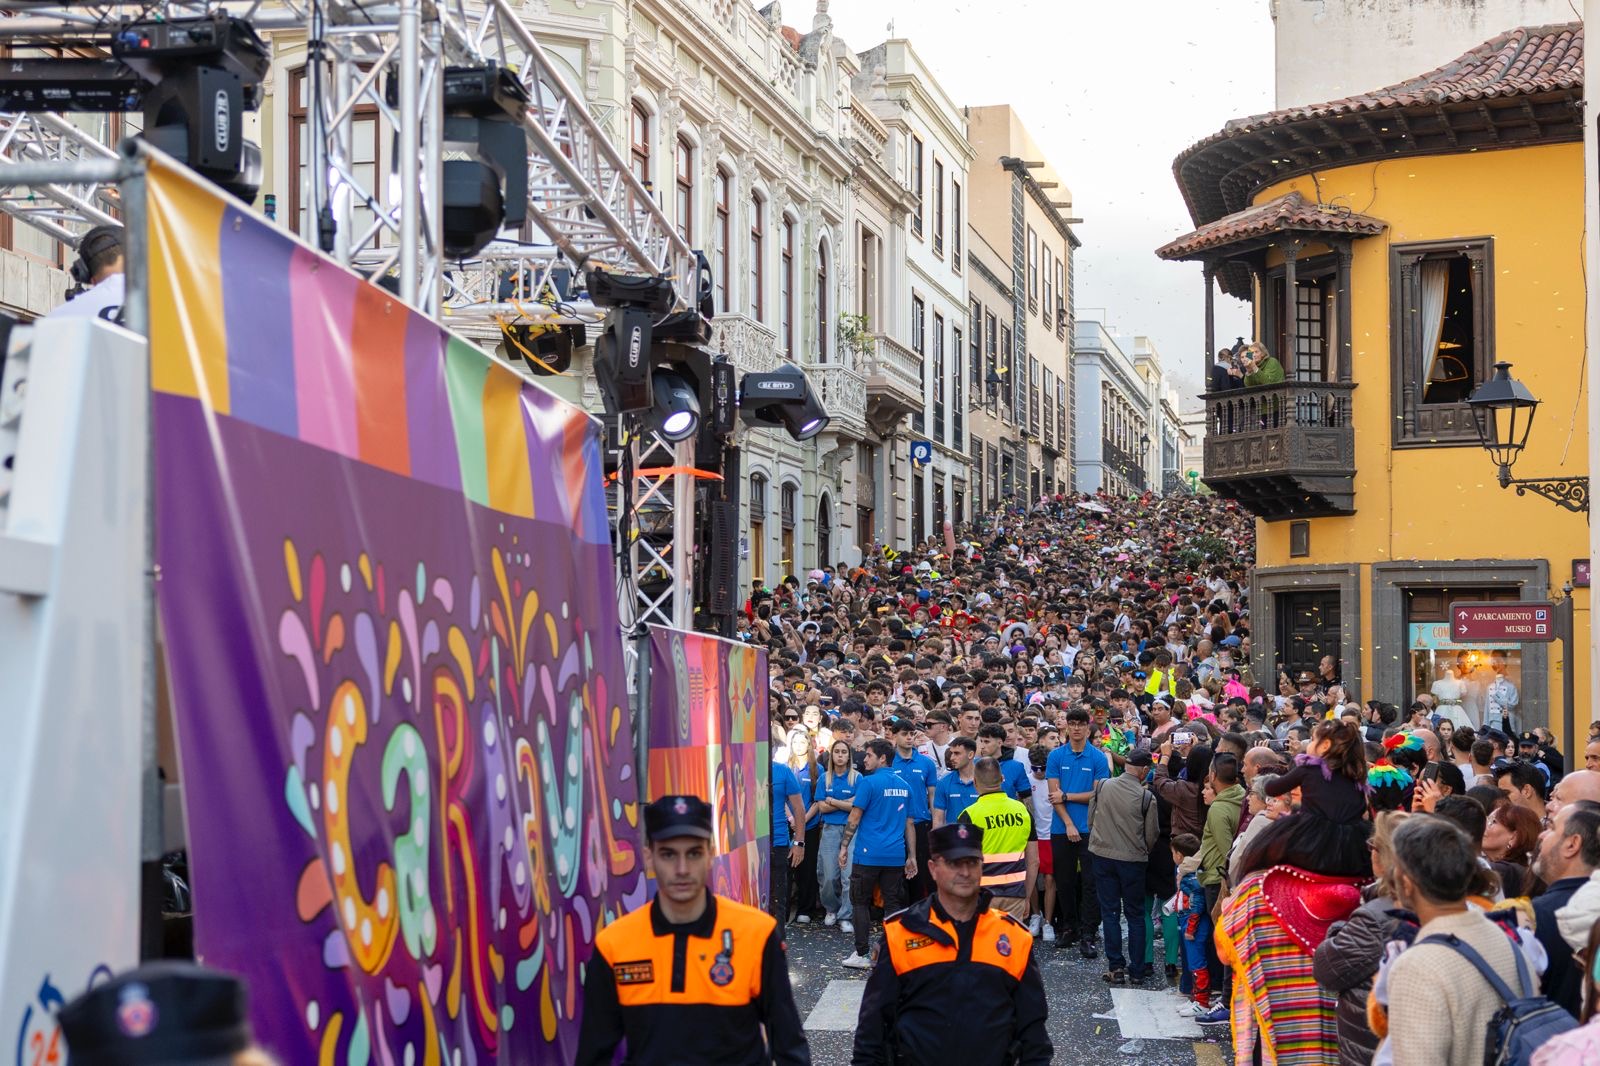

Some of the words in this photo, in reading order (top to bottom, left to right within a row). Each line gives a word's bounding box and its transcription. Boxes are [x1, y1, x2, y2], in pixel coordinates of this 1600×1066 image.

[217, 113, 227, 144] CLUB
[631, 342, 639, 363] CLUB
[1472, 612, 1532, 621] APARCAMIENTO
[1432, 626, 1450, 639] COM
[1505, 625, 1532, 633] MUSEO
[984, 812, 1024, 830] EGOS
